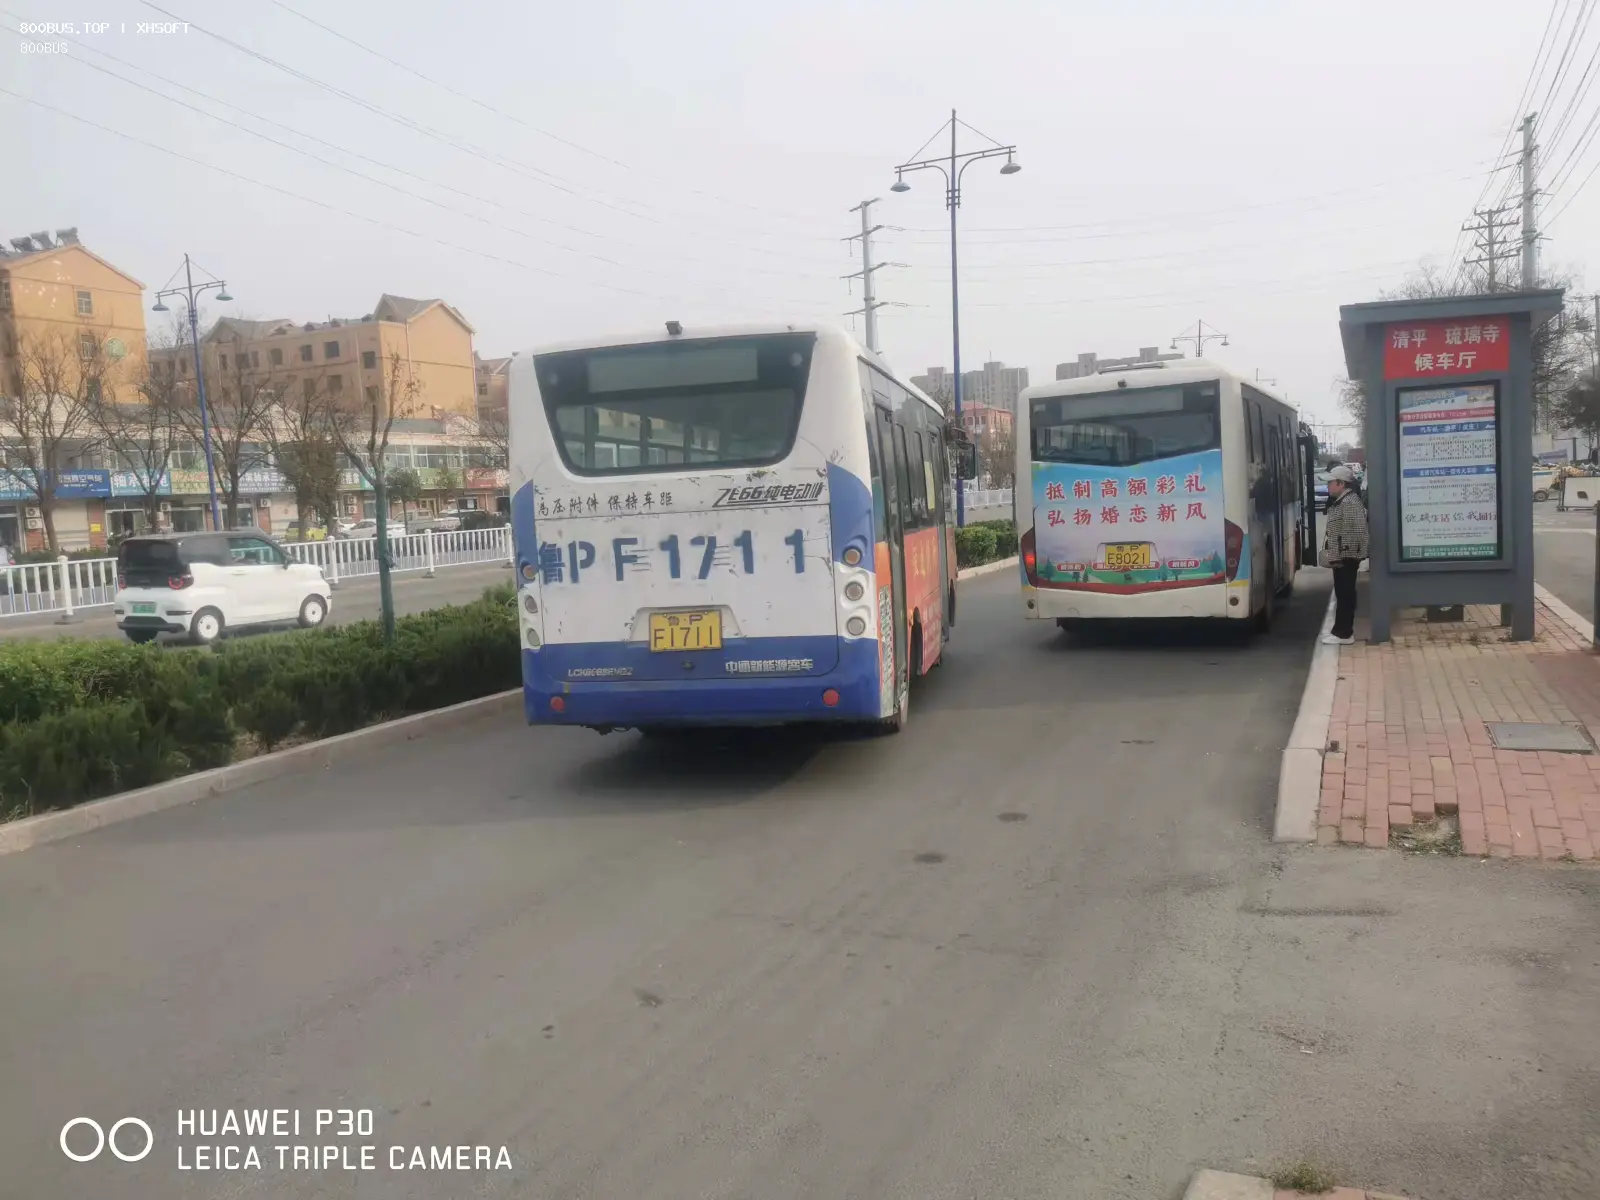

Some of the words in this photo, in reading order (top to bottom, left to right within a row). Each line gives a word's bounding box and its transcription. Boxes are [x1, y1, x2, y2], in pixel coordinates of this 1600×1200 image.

[1393, 329, 1428, 348] 清平
[1445, 325, 1500, 345] 琉璃寺
[1415, 351, 1477, 371] 候车厅
[1045, 474, 1206, 500] 抵制高额彩礼
[538, 493, 600, 516] 高压附件
[607, 491, 673, 511] 保持车距
[1047, 501, 1207, 528] 弘扬婚恋新风
[1107, 553, 1146, 565] E8021
[653, 626, 713, 648] F1711
[725, 658, 814, 674] 中通新能源客车
